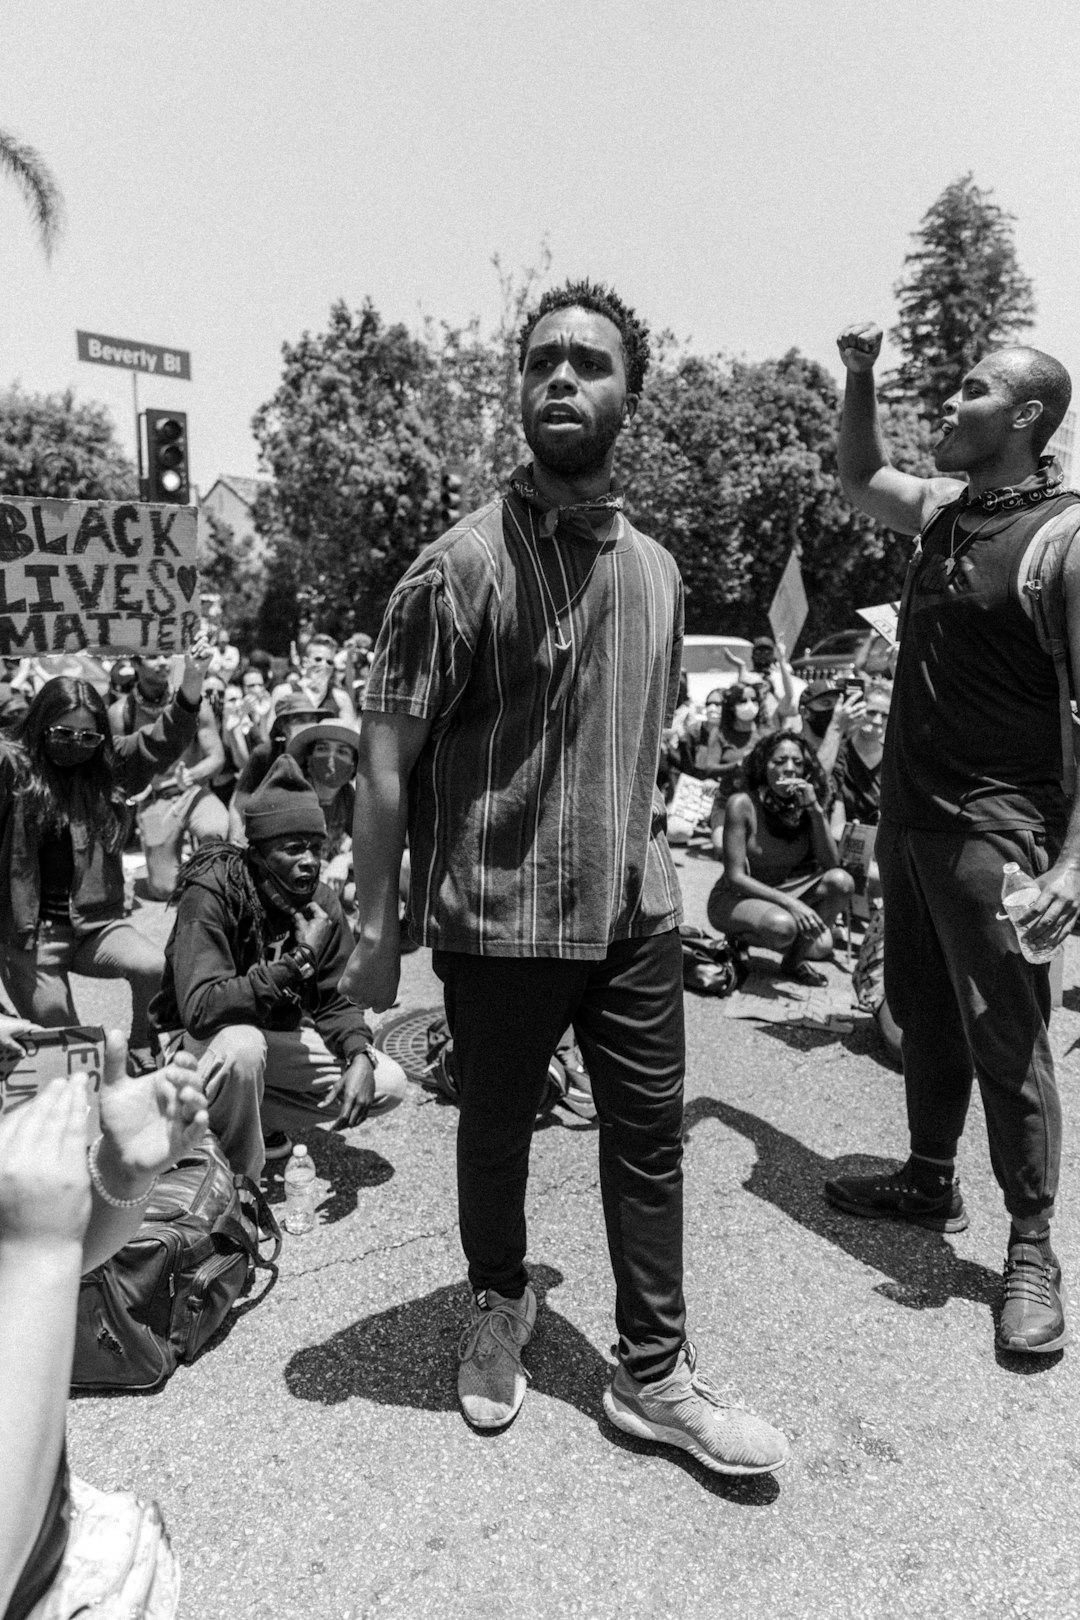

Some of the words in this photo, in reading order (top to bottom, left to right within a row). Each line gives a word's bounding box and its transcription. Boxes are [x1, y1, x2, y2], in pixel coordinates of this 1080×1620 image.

[88, 338, 158, 372] Beverly
[163, 353, 181, 373] Bl
[0, 503, 182, 562] BLACK
[0, 559, 177, 617] LIVES
[0, 611, 198, 655] MATTER
